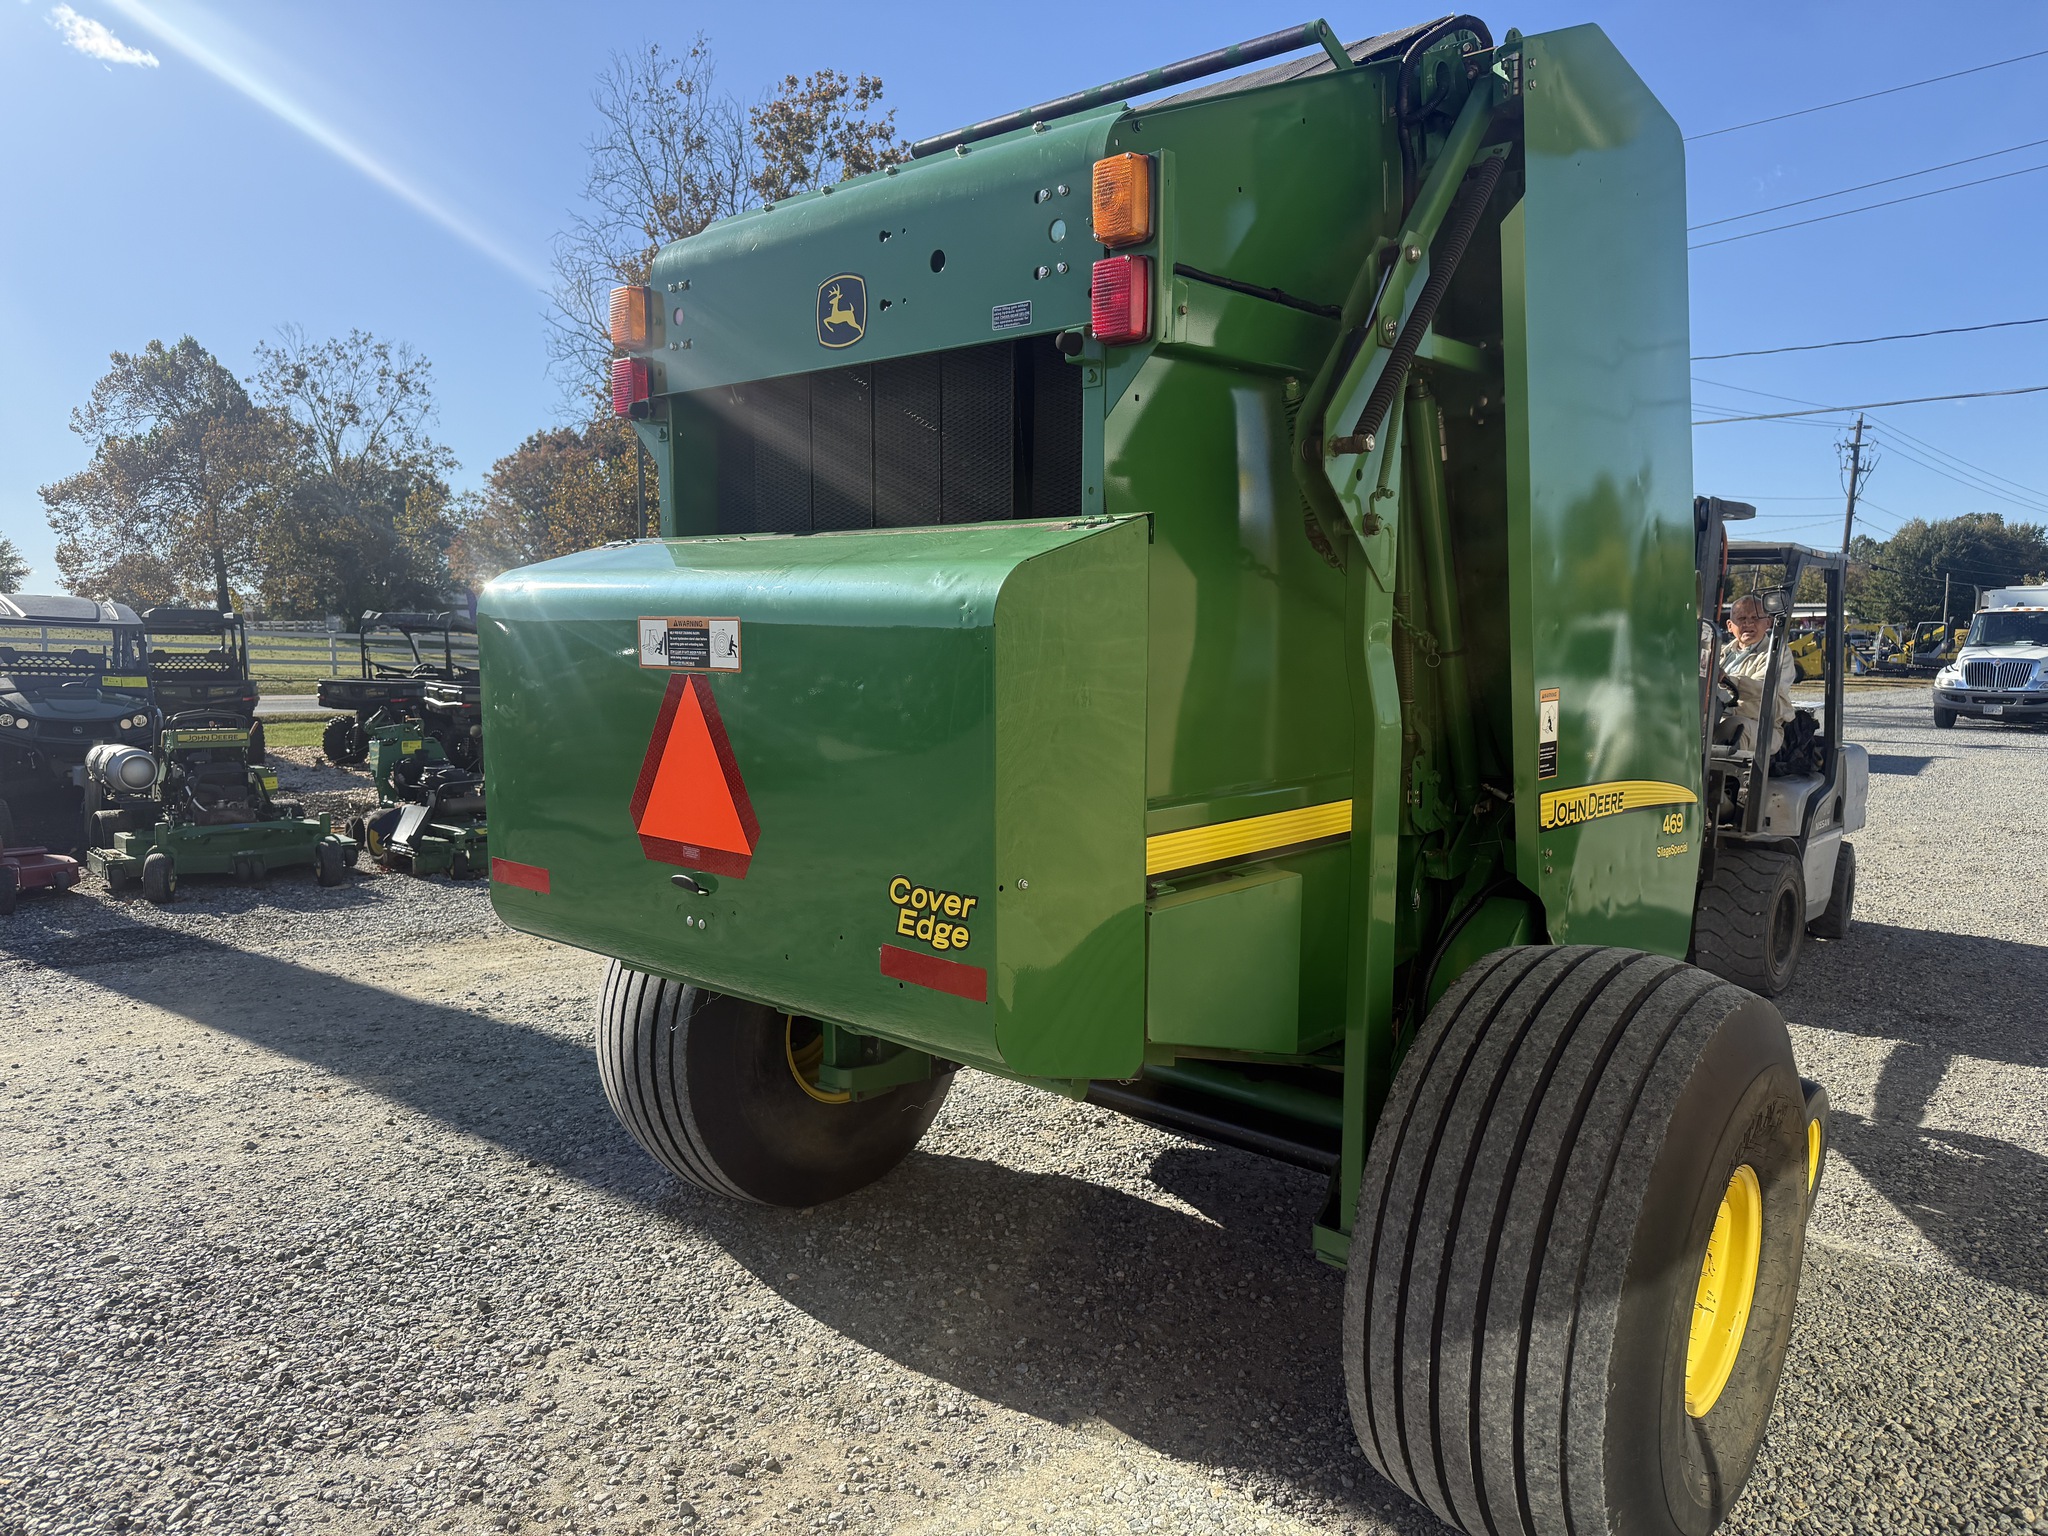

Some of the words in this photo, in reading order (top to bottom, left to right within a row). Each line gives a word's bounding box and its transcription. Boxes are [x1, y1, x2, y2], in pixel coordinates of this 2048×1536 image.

[677, 620, 703, 628] WARNING
[188, 734, 210, 742] JOHN
[211, 733, 239, 741] DEERE
[1548, 798, 1587, 825] JOHN
[1588, 791, 1624, 817] DEERE
[1662, 812, 1684, 835] 469
[1815, 818, 1830, 831] NISSAN
[889, 876, 977, 919] Cover
[897, 908, 970, 950] Edge
